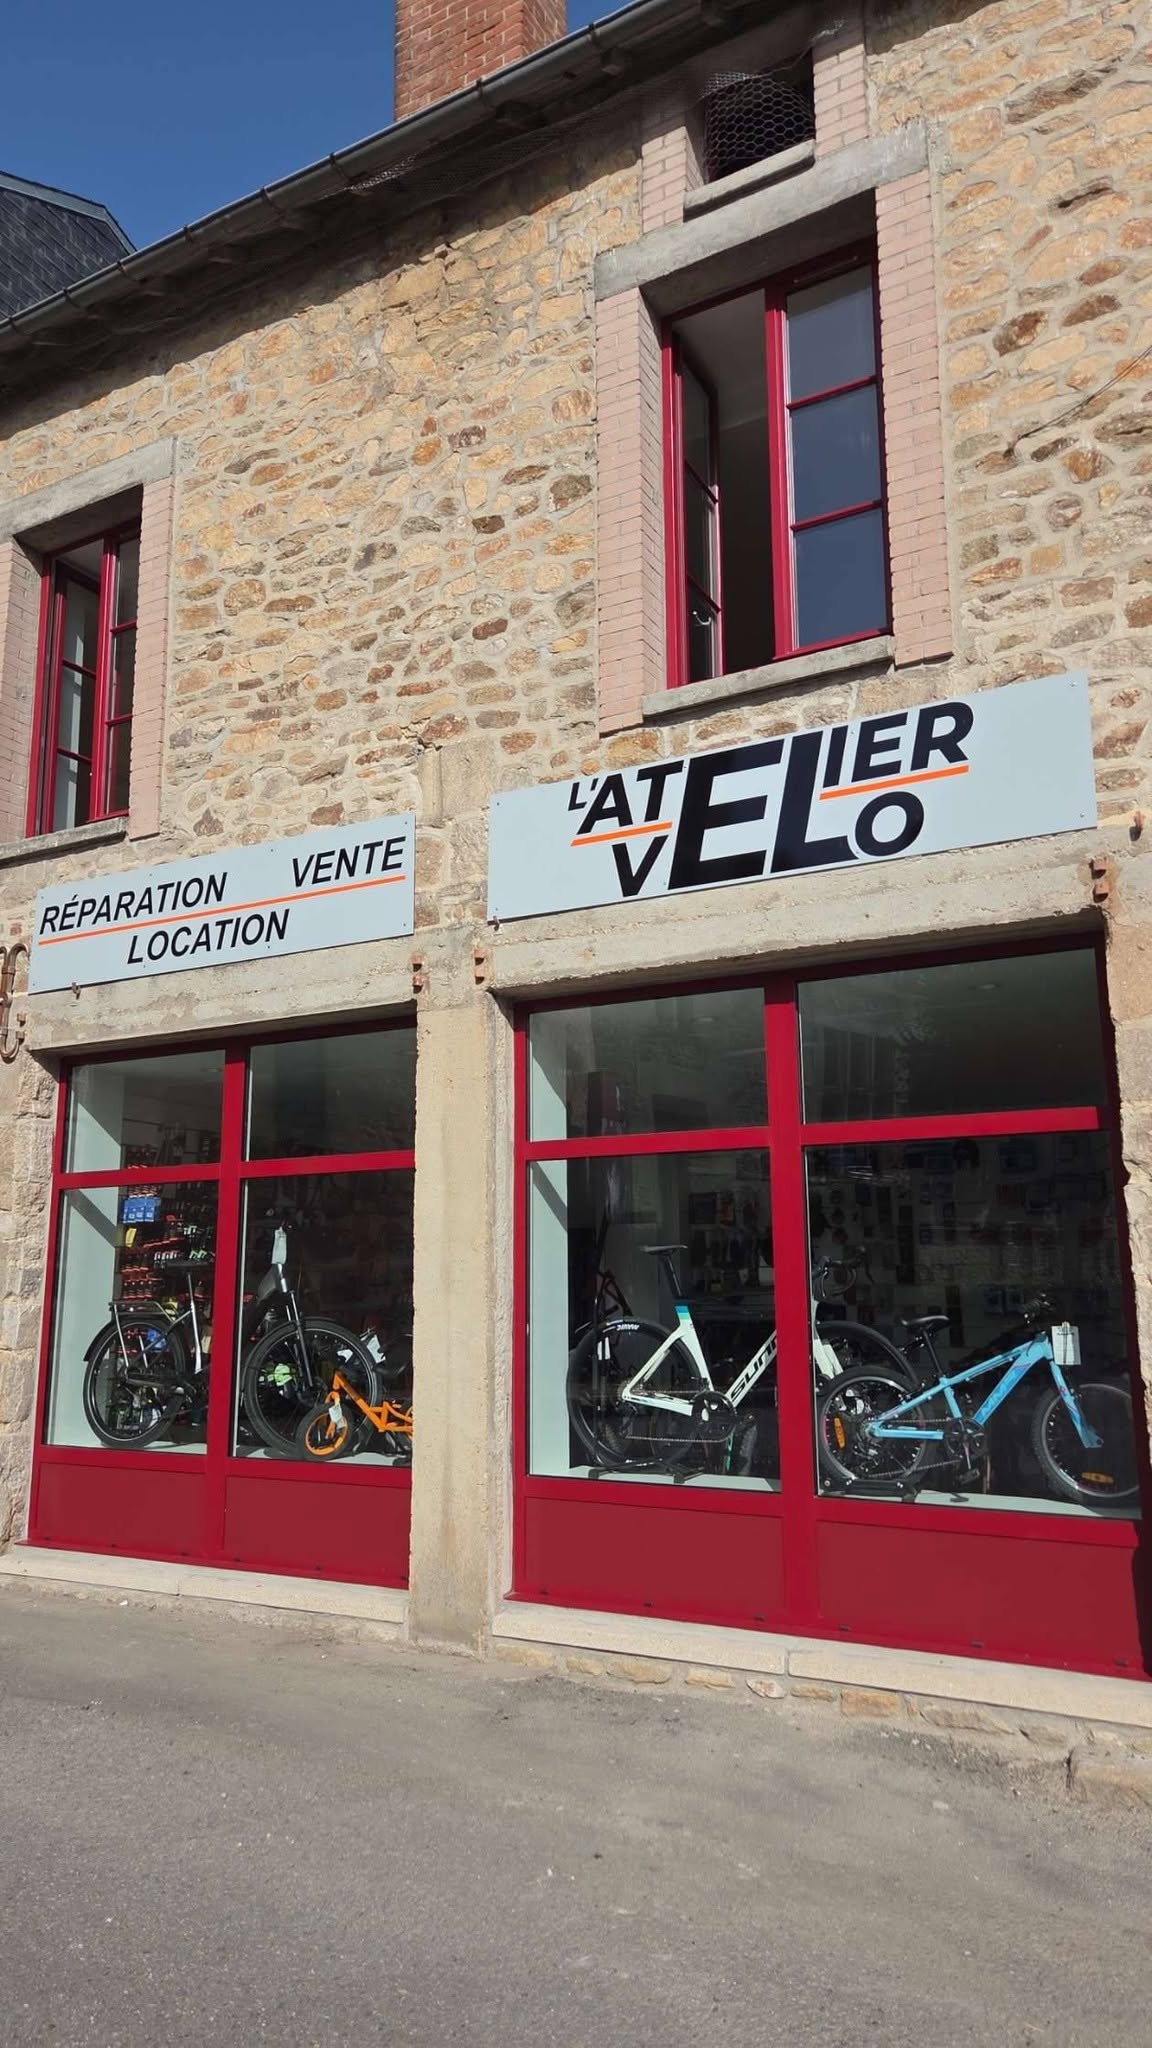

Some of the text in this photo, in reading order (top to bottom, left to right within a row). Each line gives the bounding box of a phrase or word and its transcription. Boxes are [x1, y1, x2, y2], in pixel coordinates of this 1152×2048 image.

[568, 702, 974, 890] L'ATELIER
[40, 837, 406, 935] RÉPARATION VENTE
[127, 909, 290, 965] LOCATION
